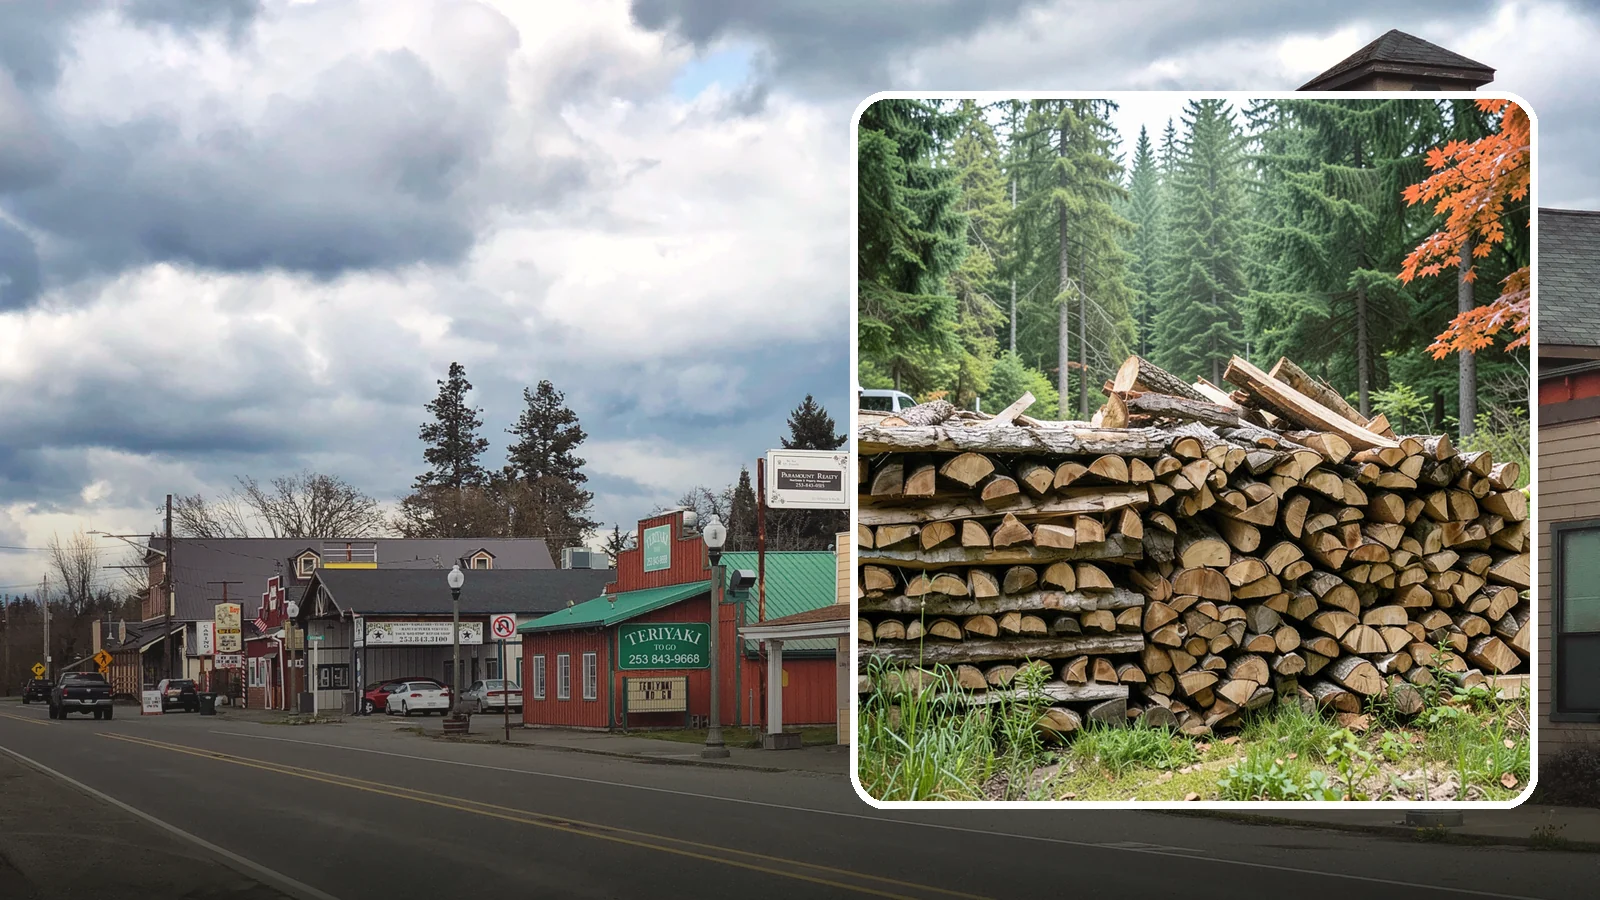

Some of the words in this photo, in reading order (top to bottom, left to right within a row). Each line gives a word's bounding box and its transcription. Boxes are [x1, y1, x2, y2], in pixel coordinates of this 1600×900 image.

[625, 627, 702, 646] TERIYAKI
[629, 654, 649, 664] 253
[651, 653, 700, 664] 843-9668
[639, 681, 672, 690] TERIYAKI
